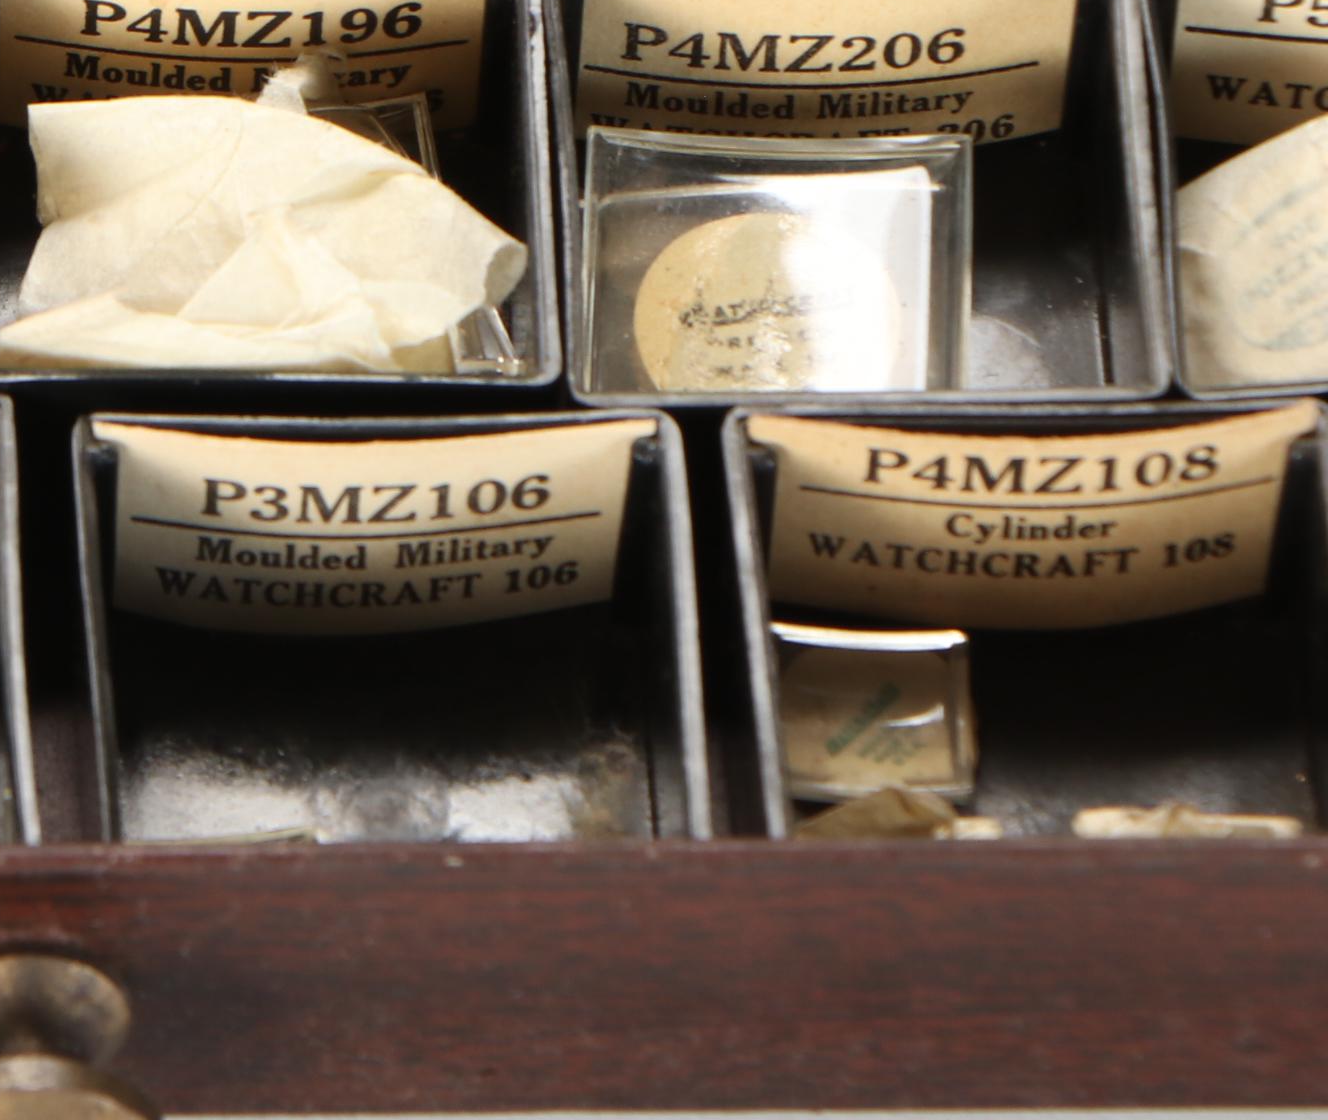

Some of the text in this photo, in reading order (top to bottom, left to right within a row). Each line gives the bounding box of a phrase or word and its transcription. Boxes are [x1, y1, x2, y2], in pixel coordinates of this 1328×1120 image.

[80, 0, 425, 49] P4MZ196
[620, 21, 966, 74] P4MZ206
[64, 52, 232, 91] Moulded
[624, 81, 974, 120] Moulded Military
[863, 445, 1221, 494] P4MZ108
[201, 474, 551, 524] P3MZ106
[195, 535, 555, 571] Moulded Military
[946, 513, 1119, 545] Cylinder
[806, 531, 1236, 580] WATCHCRAFT 108
[155, 560, 580, 609] WATCHCRAFT 106
